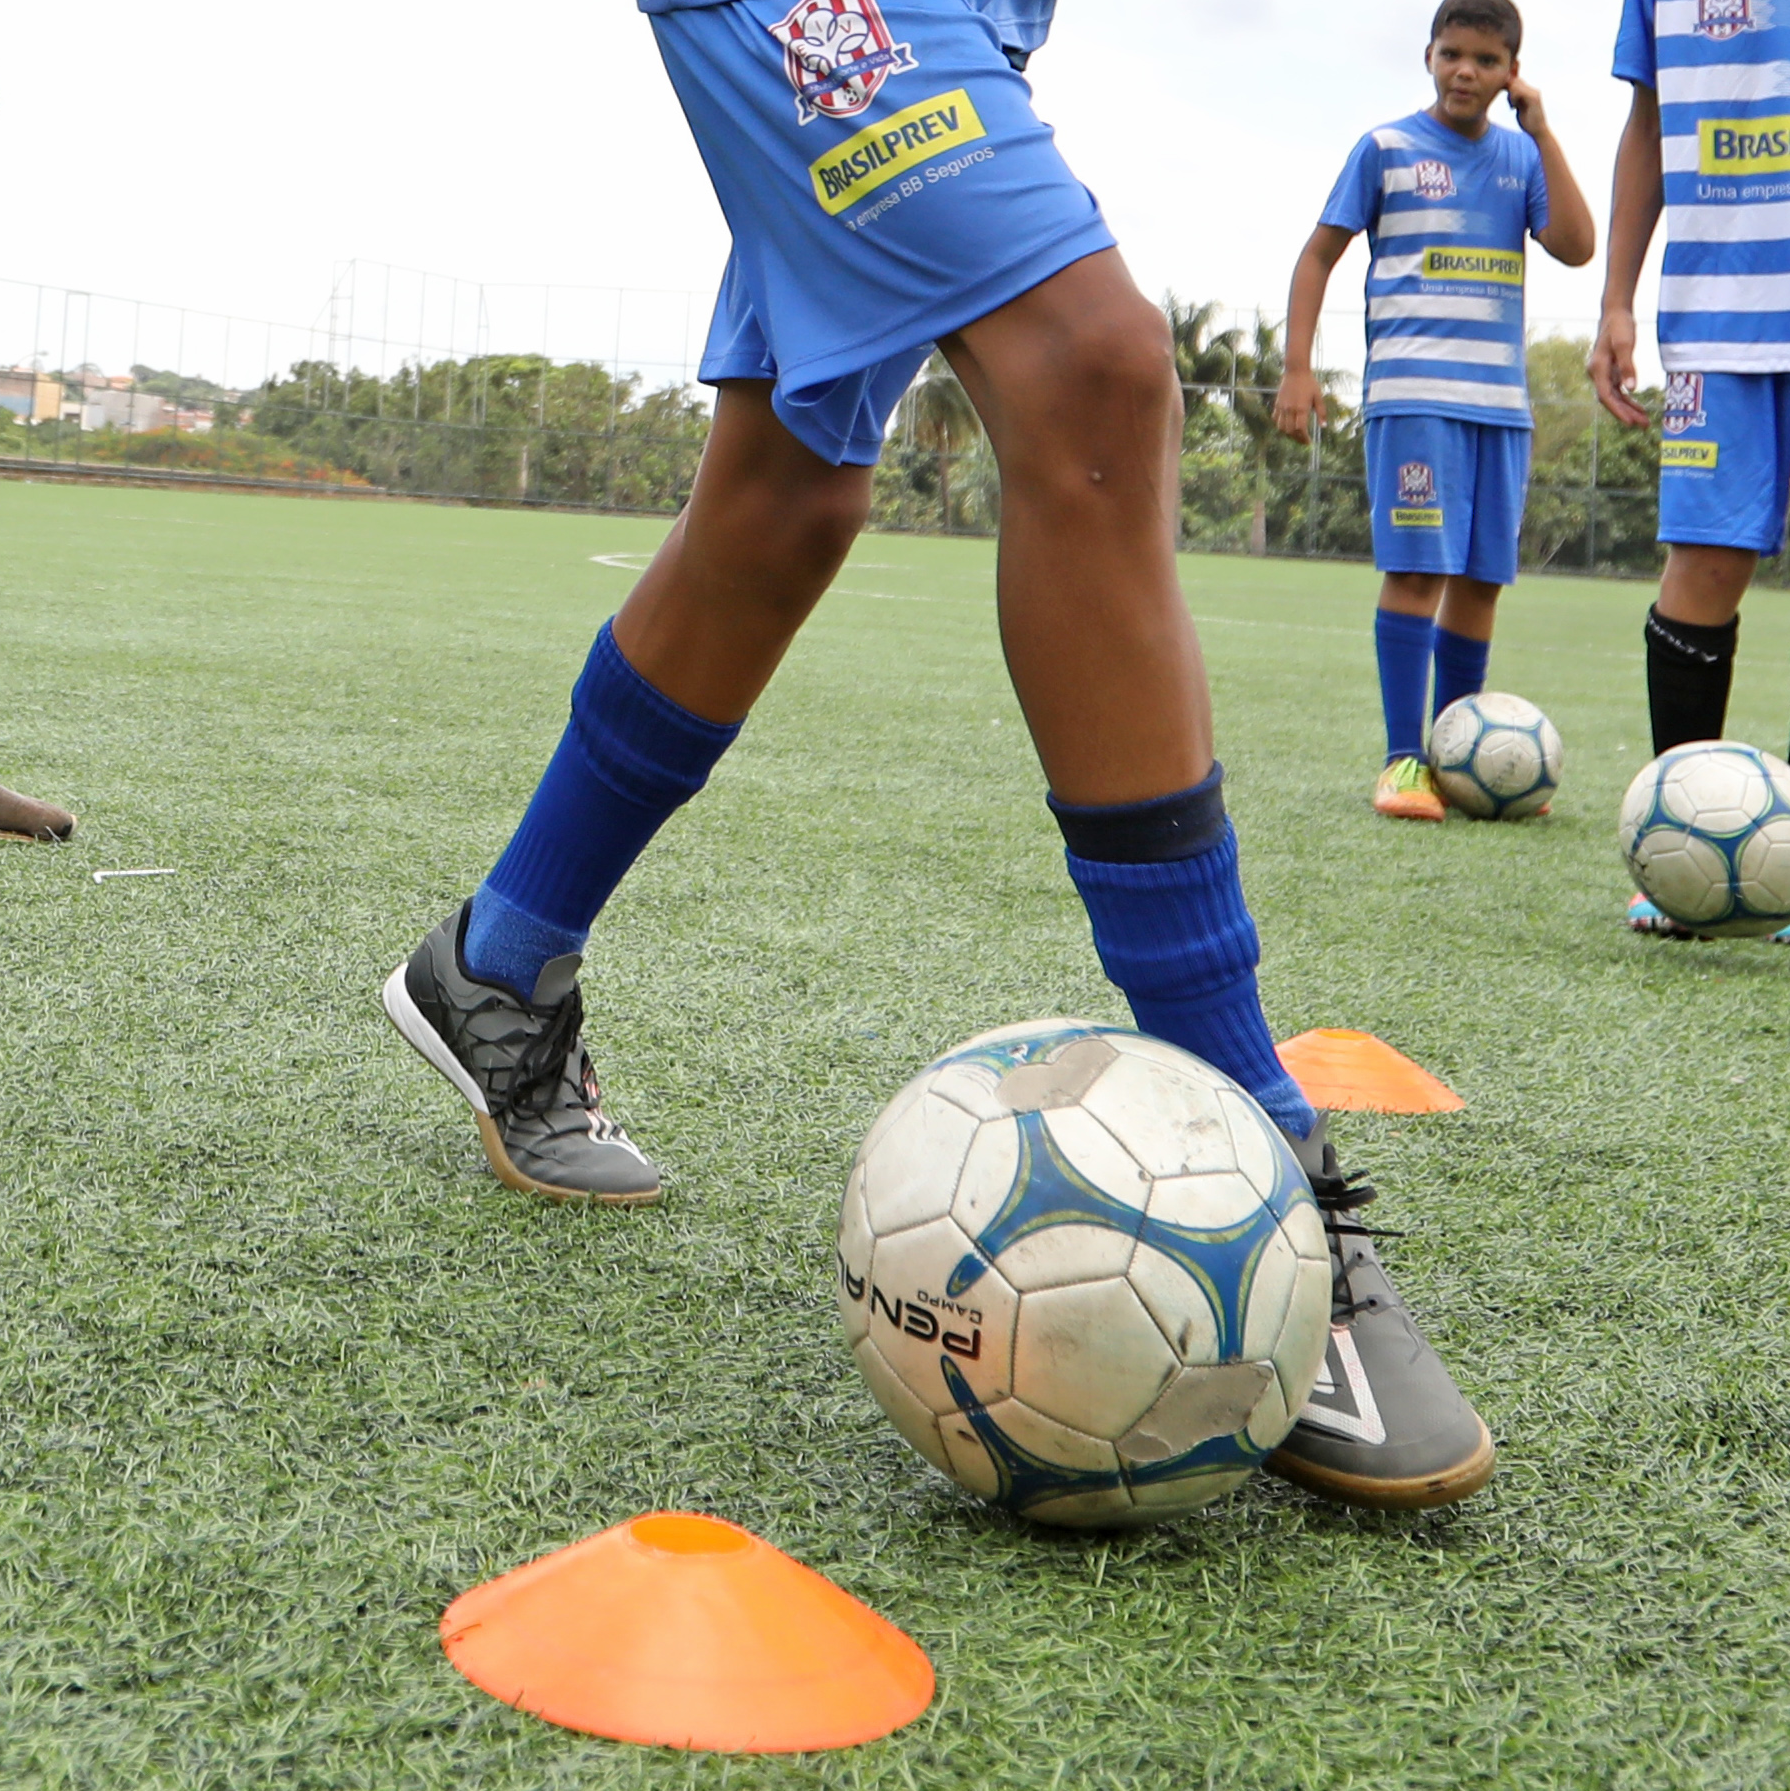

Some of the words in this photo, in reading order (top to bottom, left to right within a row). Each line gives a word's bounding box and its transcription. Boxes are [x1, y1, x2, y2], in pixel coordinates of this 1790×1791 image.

[818, 105, 960, 200] BRASILPREV
[856, 191, 902, 227] empresa
[899, 175, 924, 199] BB
[924, 146, 996, 184] Seguros
[1698, 183, 1737, 200] Uma
[1430, 252, 1522, 276] BRASILPREV
[1421, 283, 1443, 292] Uma
[917, 1289, 983, 1325] CAMPO
